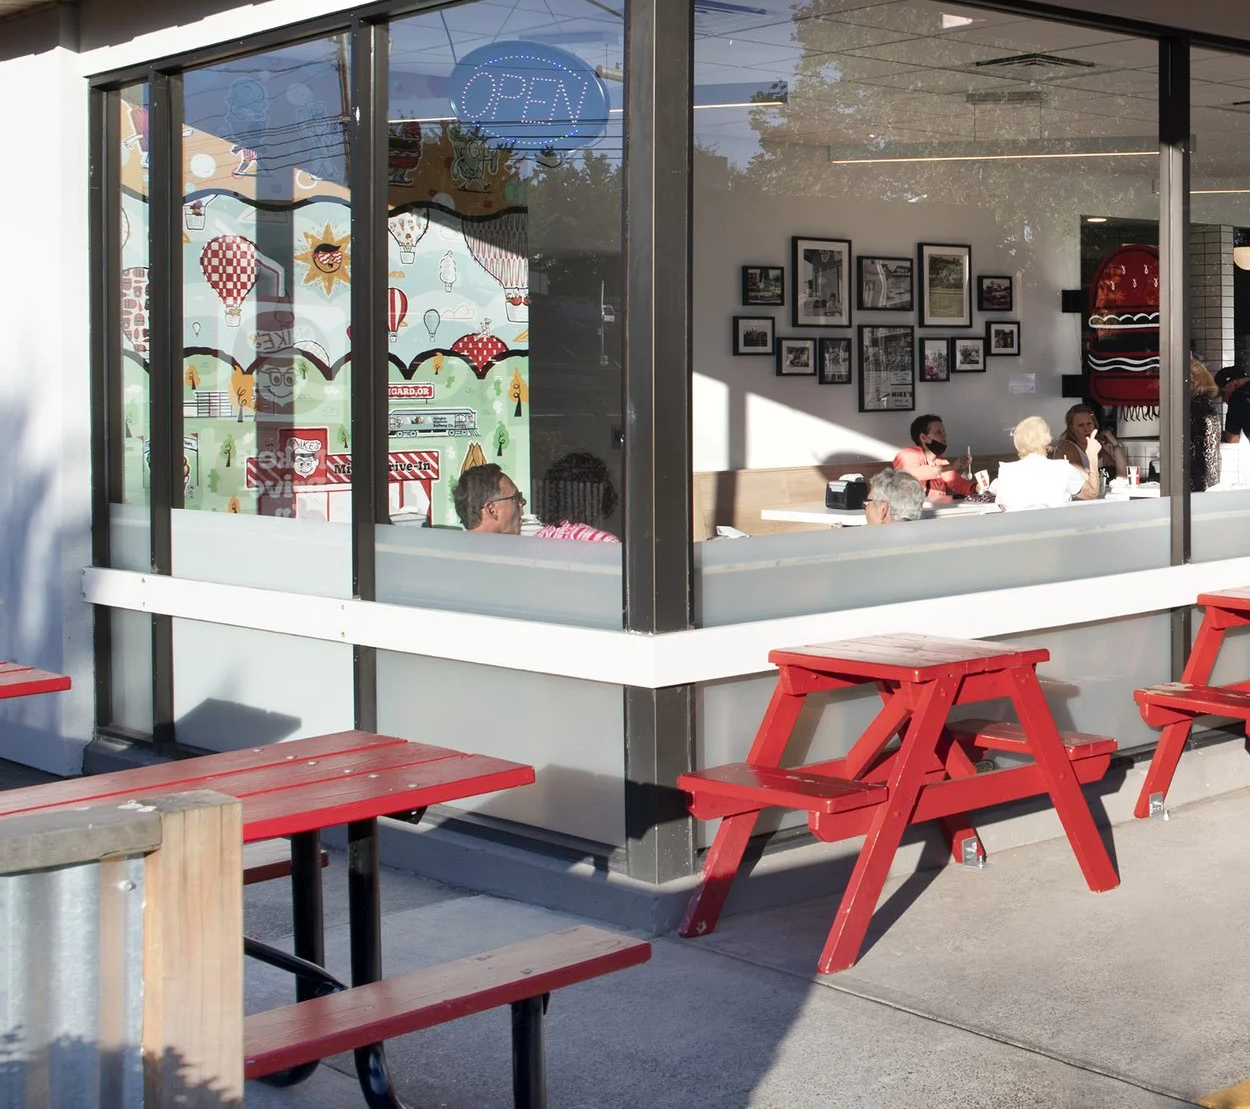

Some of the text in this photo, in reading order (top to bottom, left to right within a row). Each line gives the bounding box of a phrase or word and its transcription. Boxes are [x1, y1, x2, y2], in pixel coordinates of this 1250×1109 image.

[462, 71, 588, 125] OPEN
[389, 386, 430, 396] IGARD,OR
[389, 461, 431, 471] rive-In
